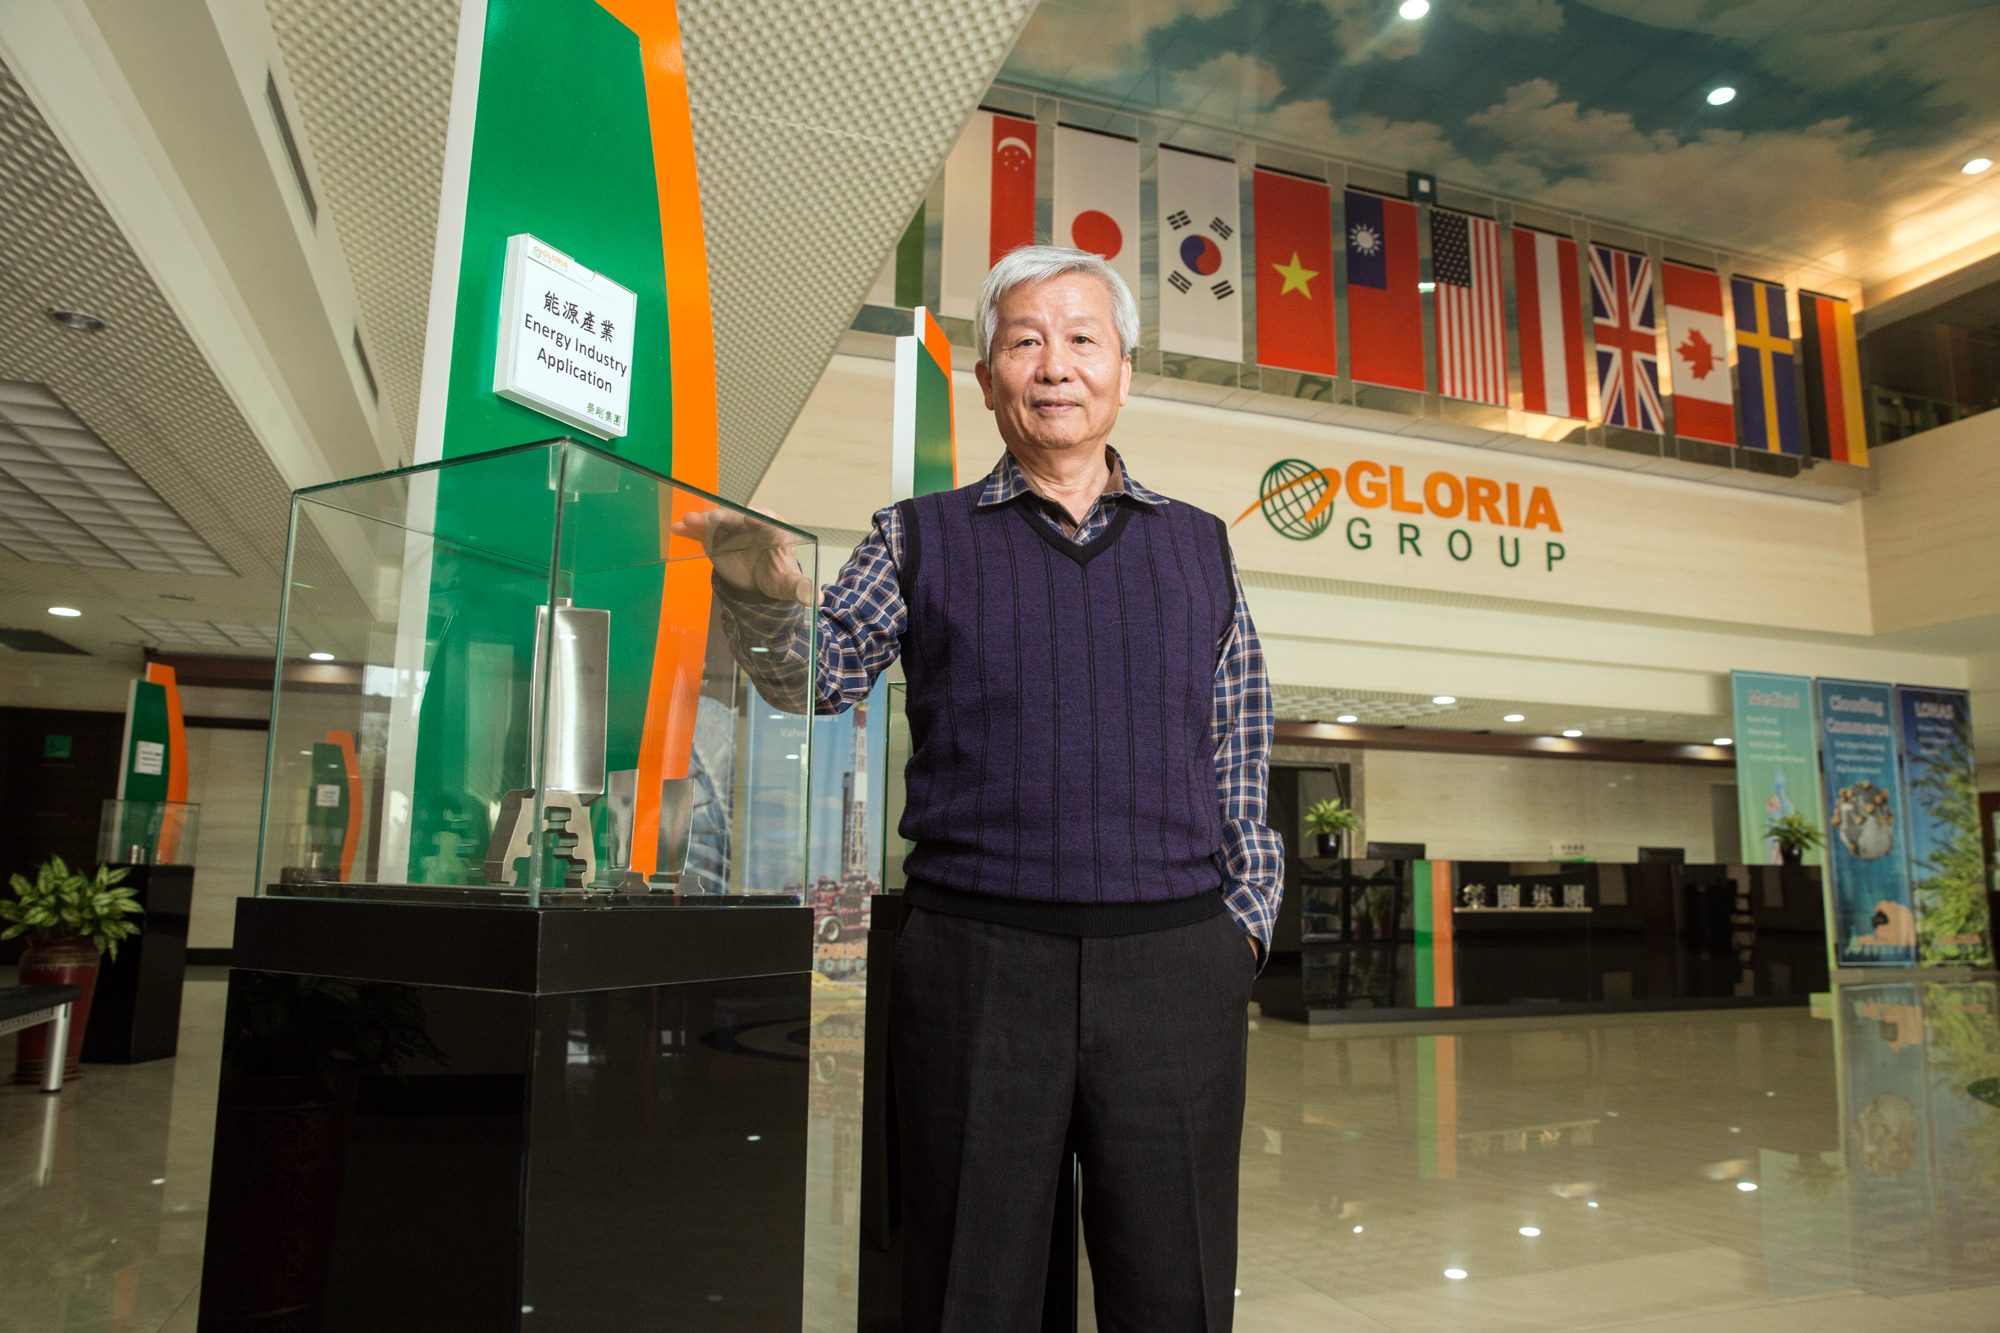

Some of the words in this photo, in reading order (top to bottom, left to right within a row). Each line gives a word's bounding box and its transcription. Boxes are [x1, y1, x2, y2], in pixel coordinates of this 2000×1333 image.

[542, 250, 569, 269] GLORIA
[543, 290, 615, 343] 能源產業
[524, 313, 571, 350] Energy
[575, 337, 628, 377] Industry
[537, 347, 613, 394] Application
[1345, 460, 1564, 533] GLORIA
[1346, 517, 1566, 572] GROUP
[813, 943, 866, 959] ORIA
